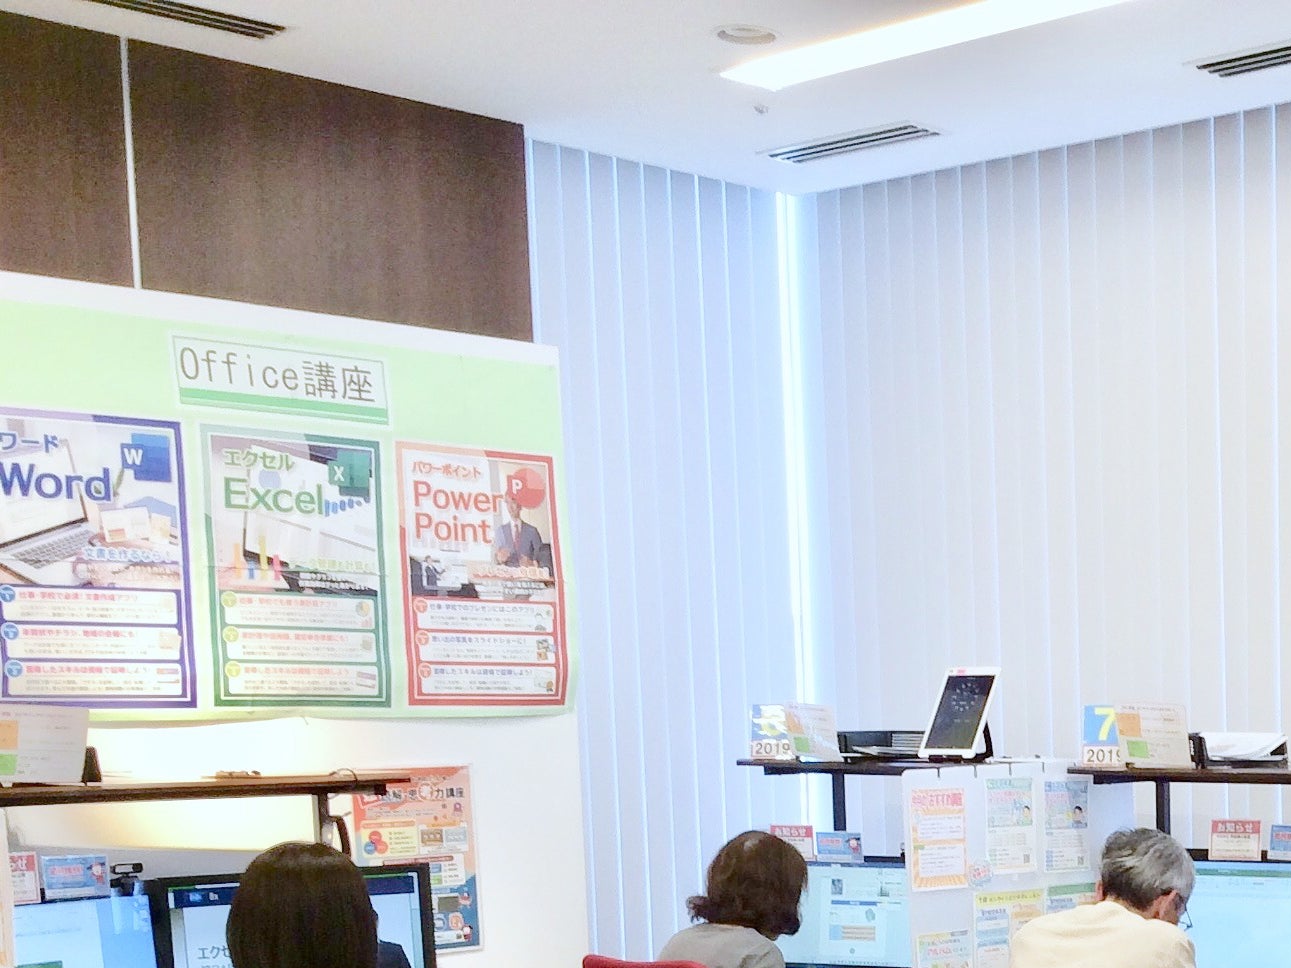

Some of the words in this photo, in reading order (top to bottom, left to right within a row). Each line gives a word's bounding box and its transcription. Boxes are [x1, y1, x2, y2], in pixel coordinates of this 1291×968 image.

[180, 347, 375, 402] Office講座
[0, 432, 60, 453] ワード
[123, 448, 143, 466] W
[224, 450, 295, 471] エクセル
[412, 461, 481, 479] パワーポイント
[0, 462, 112, 501] Word
[223, 476, 324, 515] Excel
[413, 480, 503, 513] Power
[415, 512, 492, 544] Point
[1094, 707, 1116, 741] 7
[755, 743, 790, 754] 2019
[1217, 822, 1253, 833] お知らせ
